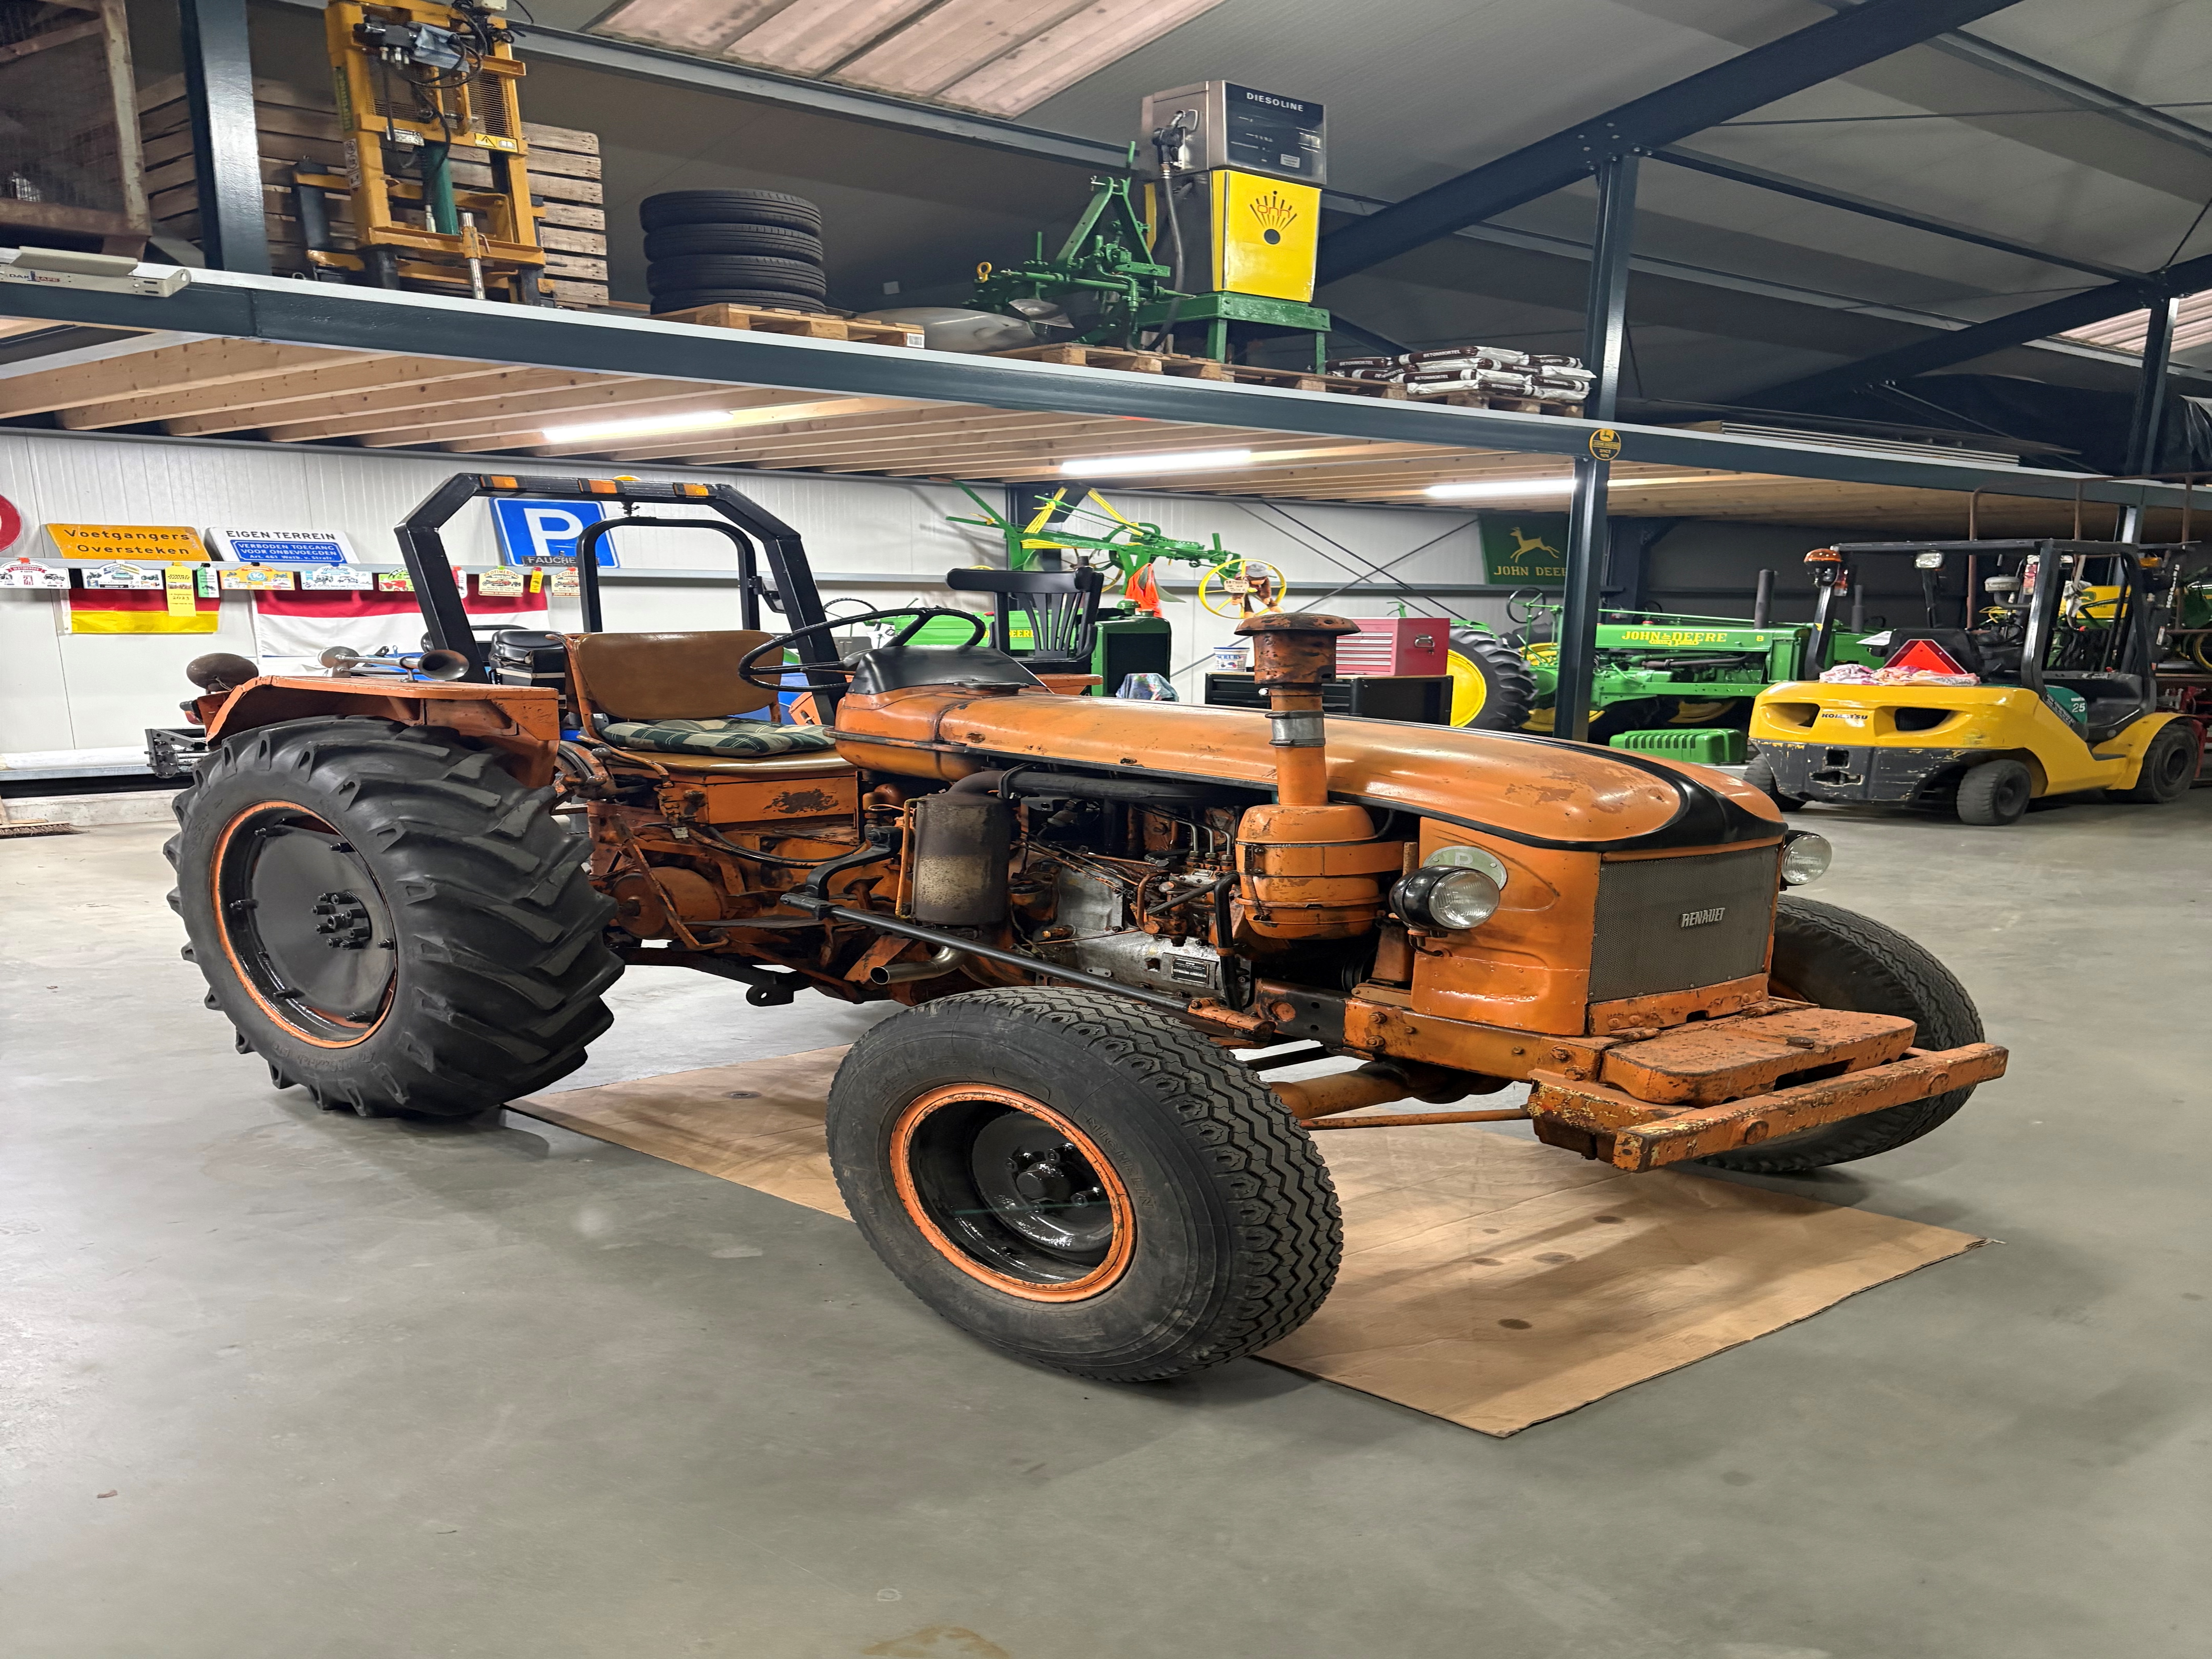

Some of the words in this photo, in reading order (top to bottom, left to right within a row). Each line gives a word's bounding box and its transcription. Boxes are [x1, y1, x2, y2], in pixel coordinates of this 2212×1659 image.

[1246, 92, 1304, 112] DIESOLINE
[64, 529, 190, 541] Voetgangers
[524, 508, 584, 556] P
[77, 544, 189, 555] Oversteken
[1493, 566, 1529, 576] JOHN
[1535, 567, 1566, 576] DEE
[1621, 631, 1661, 640] JOHN
[1671, 632, 1728, 642] DEERE
[2072, 703, 2086, 713] 25
[1681, 907, 1726, 927] RENAULT
[1085, 1116, 1156, 1208] MICHELIN
